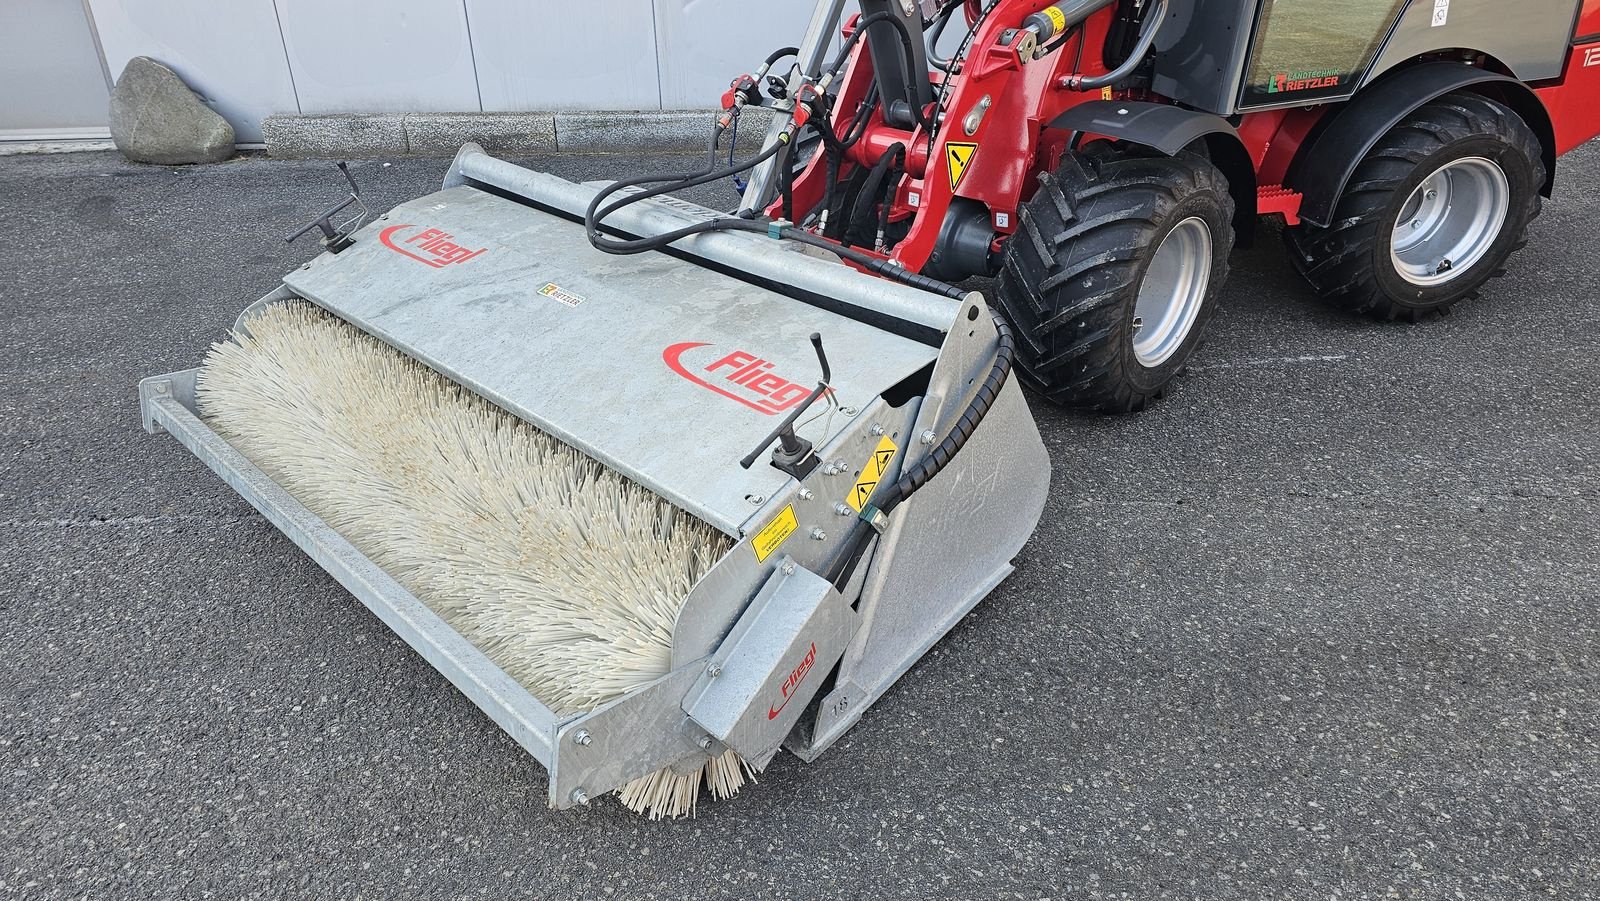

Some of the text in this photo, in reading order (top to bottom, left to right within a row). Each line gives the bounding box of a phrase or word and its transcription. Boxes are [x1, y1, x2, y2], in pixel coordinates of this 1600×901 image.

[1286, 76, 1339, 91] RIETZLER
[1288, 68, 1340, 80] LANDTECHNIK
[404, 228, 489, 266] Fliegl
[781, 641, 817, 698] Fliegl
